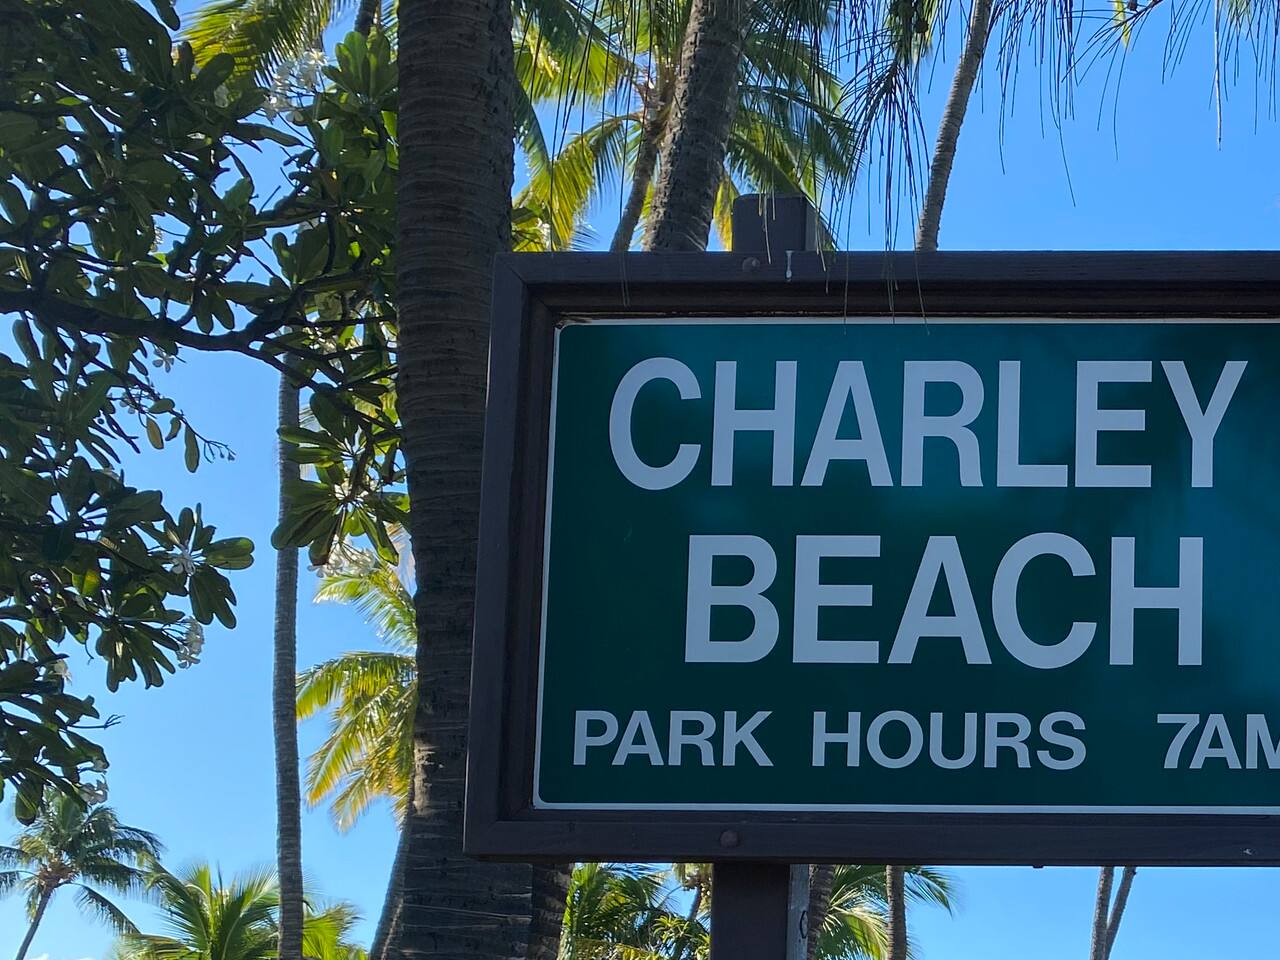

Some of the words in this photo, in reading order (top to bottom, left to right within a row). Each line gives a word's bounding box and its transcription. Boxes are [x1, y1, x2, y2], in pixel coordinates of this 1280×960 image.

[609, 358, 1248, 491] CHARLEY
[684, 532, 1204, 670] BEACH
[573, 710, 774, 768] PARK
[812, 710, 1087, 770] HOURS
